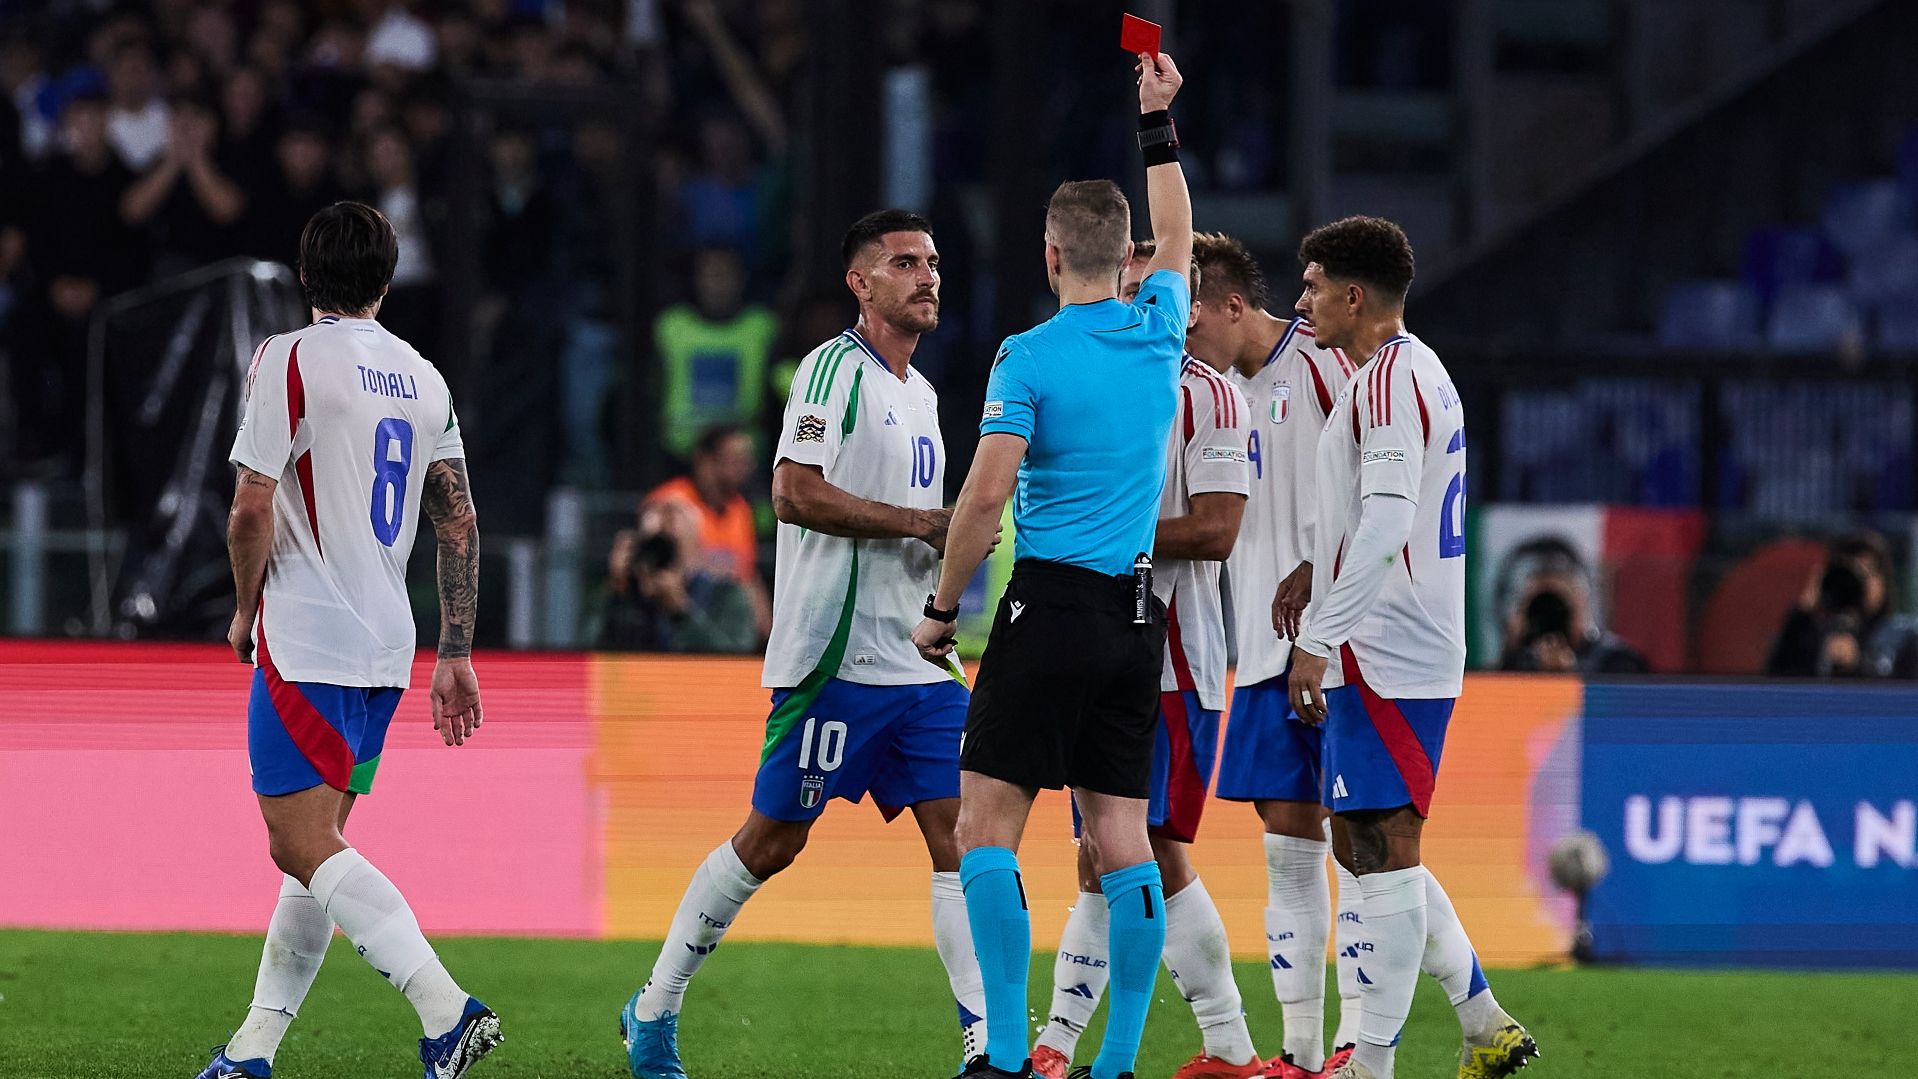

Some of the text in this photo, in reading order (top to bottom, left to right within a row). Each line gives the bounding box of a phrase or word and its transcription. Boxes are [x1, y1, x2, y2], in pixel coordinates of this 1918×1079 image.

[357, 365, 418, 400] TONALI
[370, 417, 414, 547] 8
[910, 435, 935, 489] 10
[798, 717, 848, 772] 10
[1623, 794, 1836, 868] UEFA
[1337, 911, 1364, 925] ITAL
[1061, 951, 1107, 969] ITALIA
